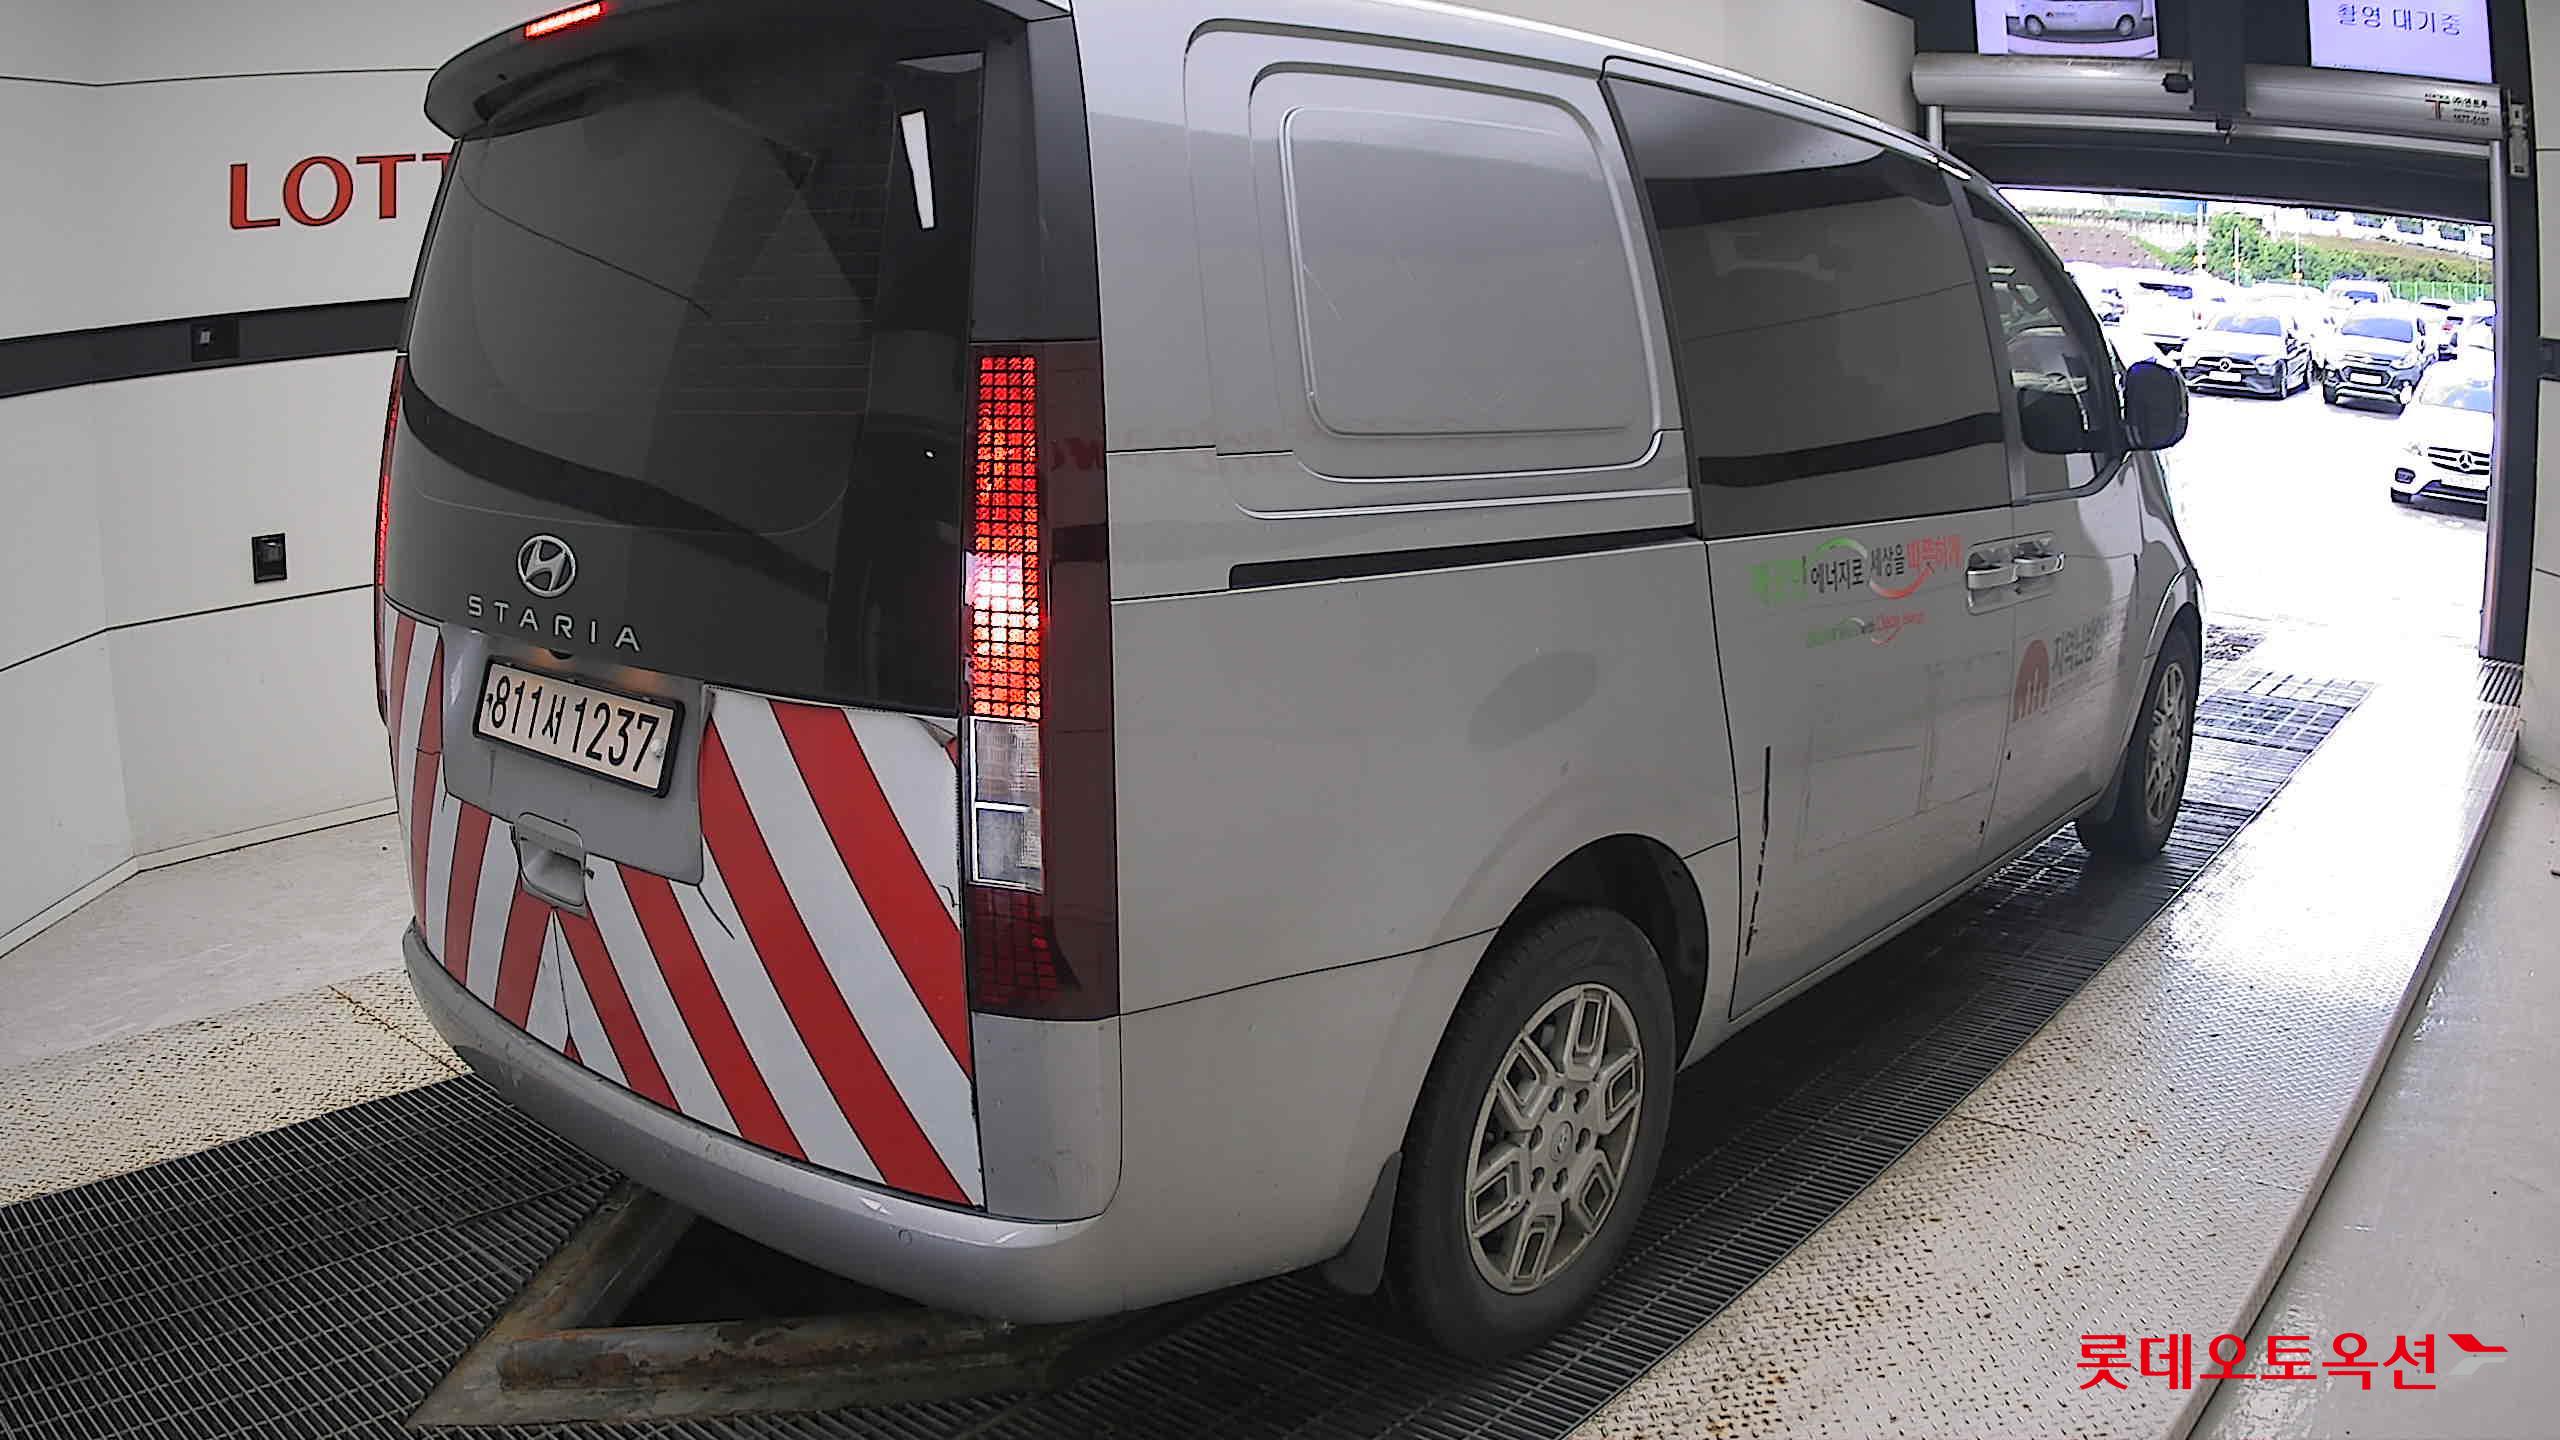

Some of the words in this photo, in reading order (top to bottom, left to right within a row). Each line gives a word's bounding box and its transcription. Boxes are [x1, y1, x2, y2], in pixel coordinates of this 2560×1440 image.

[2392, 7, 2461, 36] 대기중
[1810, 558, 1865, 594] 에너지로
[1871, 543, 1906, 577] 세상을
[467, 594, 642, 653] STARIA
